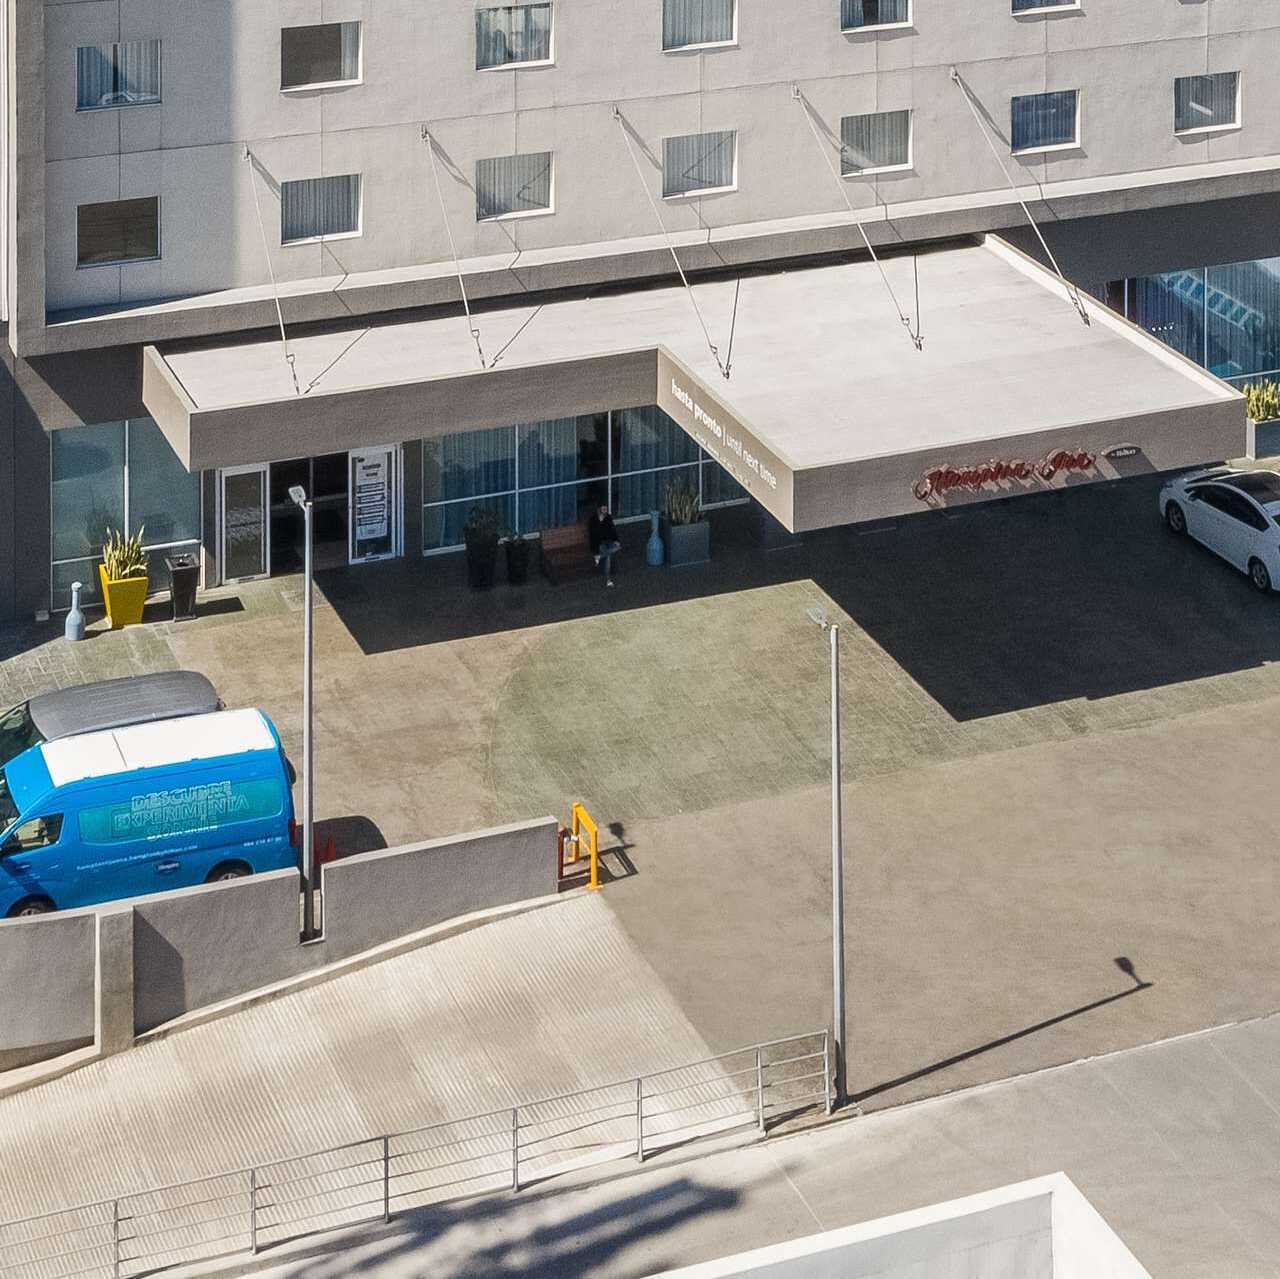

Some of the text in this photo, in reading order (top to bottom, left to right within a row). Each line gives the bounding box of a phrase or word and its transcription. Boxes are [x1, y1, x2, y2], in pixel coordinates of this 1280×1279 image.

[671, 378, 694, 411] hasta
[694, 402, 722, 439] pronto
[742, 449, 759, 473] next
